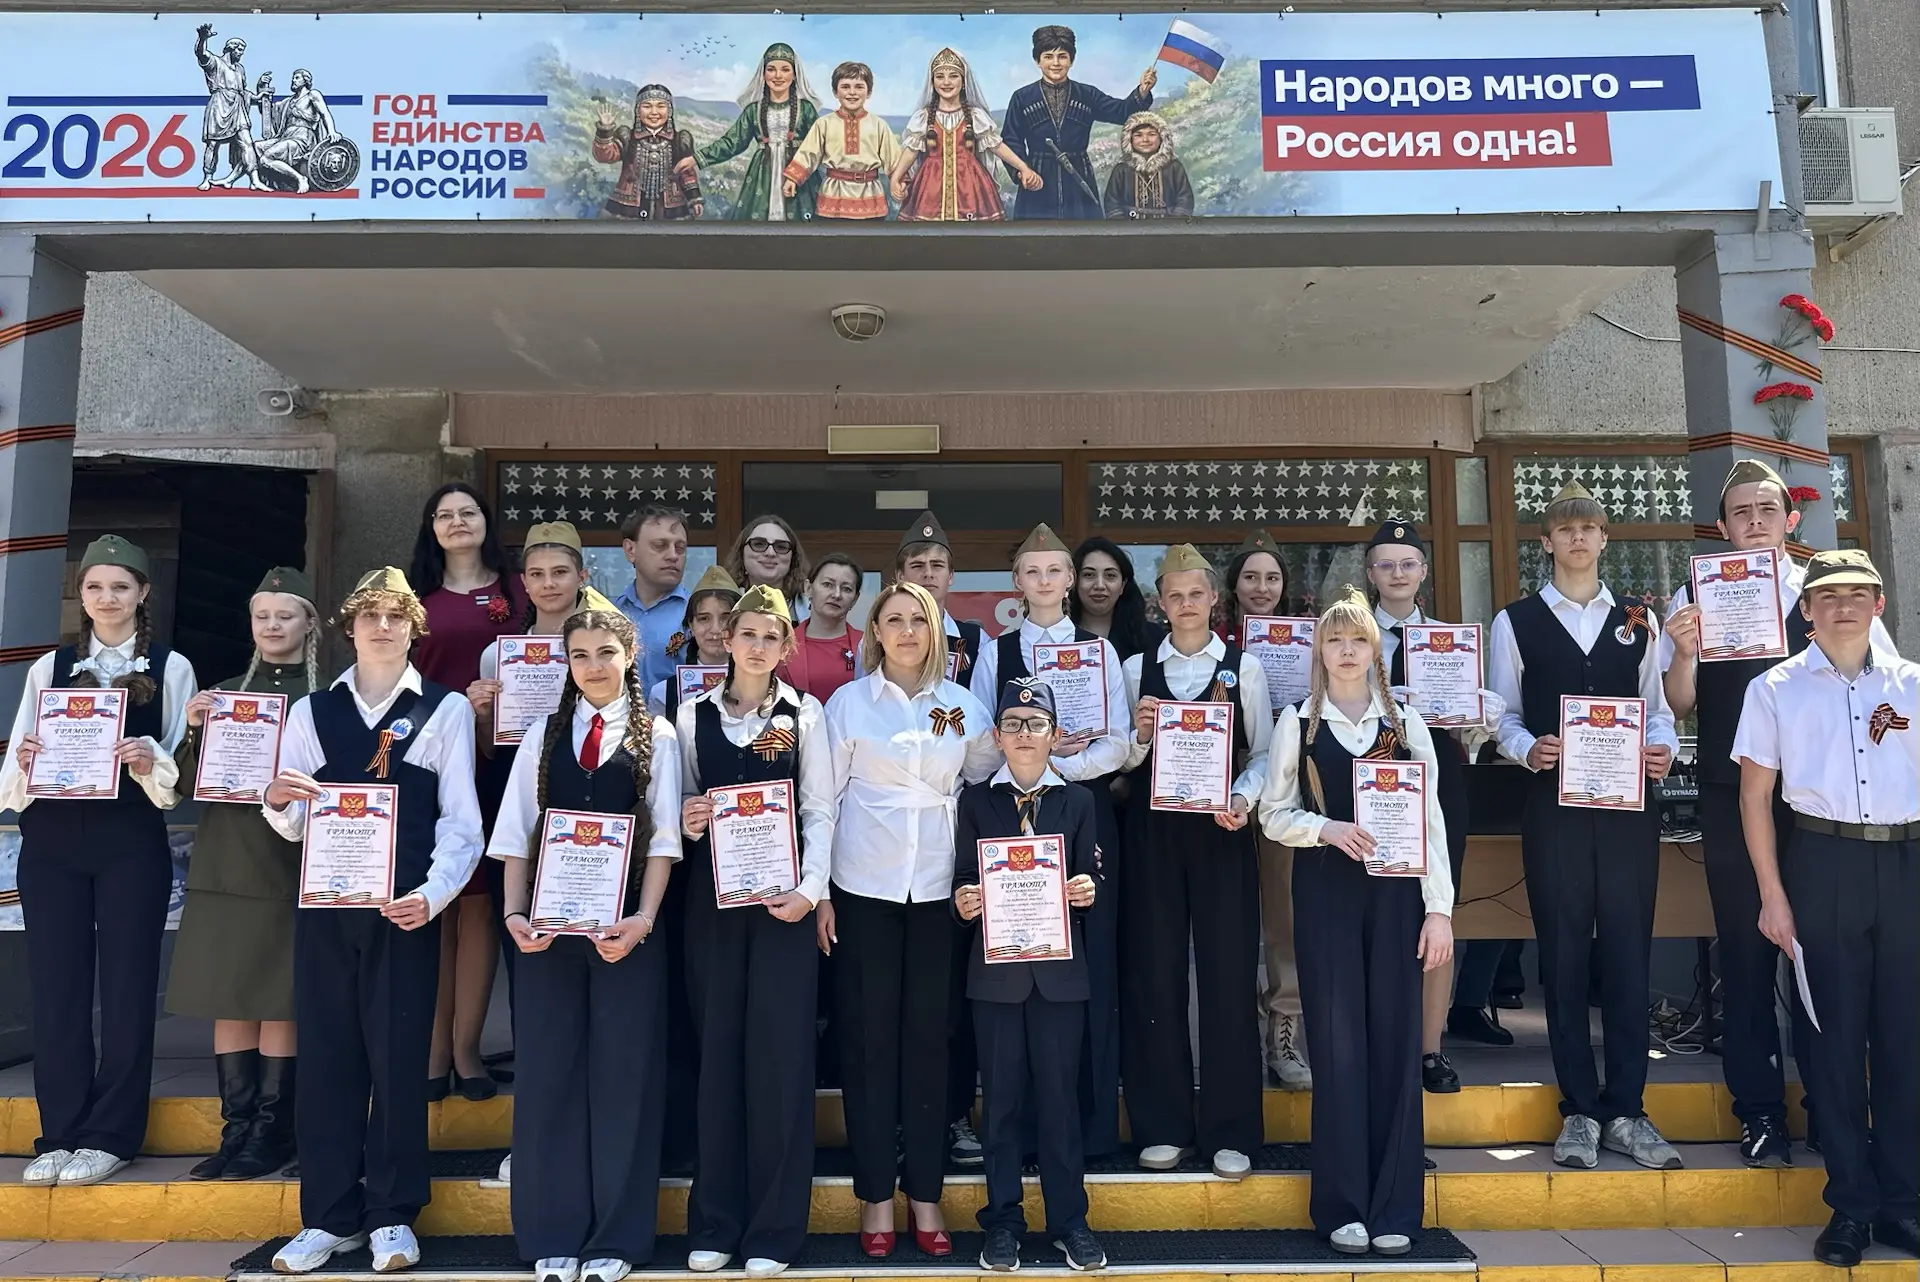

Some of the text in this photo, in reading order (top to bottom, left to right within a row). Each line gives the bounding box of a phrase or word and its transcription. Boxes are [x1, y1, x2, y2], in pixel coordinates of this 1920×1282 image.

[1273, 67, 1473, 111] Народов
[1483, 73, 1619, 101] много
[373, 94, 438, 118] ГОД
[372, 121, 546, 147] ЕДИНСТВА
[1276, 120, 1578, 160] Россия одна!
[2, 113, 196, 179] 2026
[371, 149, 529, 174] НАРОДОВ
[370, 176, 509, 200] РОССИИ
[1713, 588, 1761, 598] ГРАМОТА
[1260, 652, 1300, 661] ГРАМОТА
[1051, 677, 1091, 685] ГРАМОТА
[55, 727, 103, 735] ГРАМОТА
[221, 731, 265, 740] ГРАМОТА
[1172, 740, 1215, 749] ГРАМОТА
[1579, 736, 1626, 745] ГРАМОТА
[1369, 801, 1409, 809] ГРАМОТА
[326, 828, 377, 836] ГРАМОТА
[730, 824, 776, 835] ГРАМОТА
[560, 855, 609, 864] ГРАМОТА
[1000, 880, 1047, 889] ГРАМОТА
